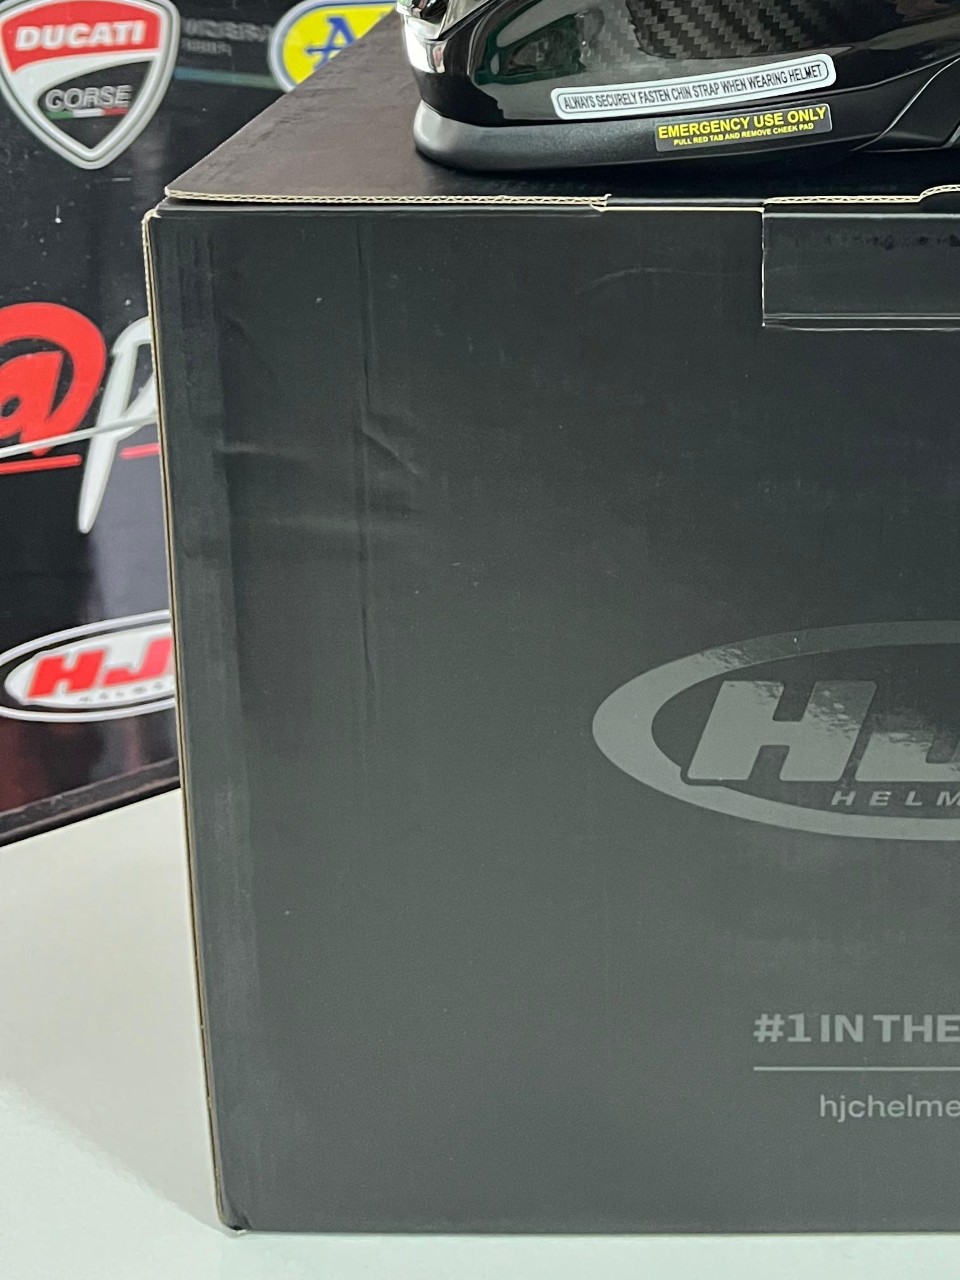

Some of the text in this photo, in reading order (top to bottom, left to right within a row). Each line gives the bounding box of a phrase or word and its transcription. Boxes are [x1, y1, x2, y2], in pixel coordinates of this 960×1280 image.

[15, 19, 146, 51] DUCATI
[45, 84, 133, 112] CORSE
[564, 64, 822, 110] ALWAYS SECURELY FASTEN CHIN STRAP WHEN WEARING HELMET
[658, 106, 827, 140] EMERGENCY USE ONLY
[673, 122, 814, 146] PULL RED TAB AND REMOVE CHEEK PAD
[753, 1012, 813, 1043] #1
[820, 1013, 864, 1043] IN
